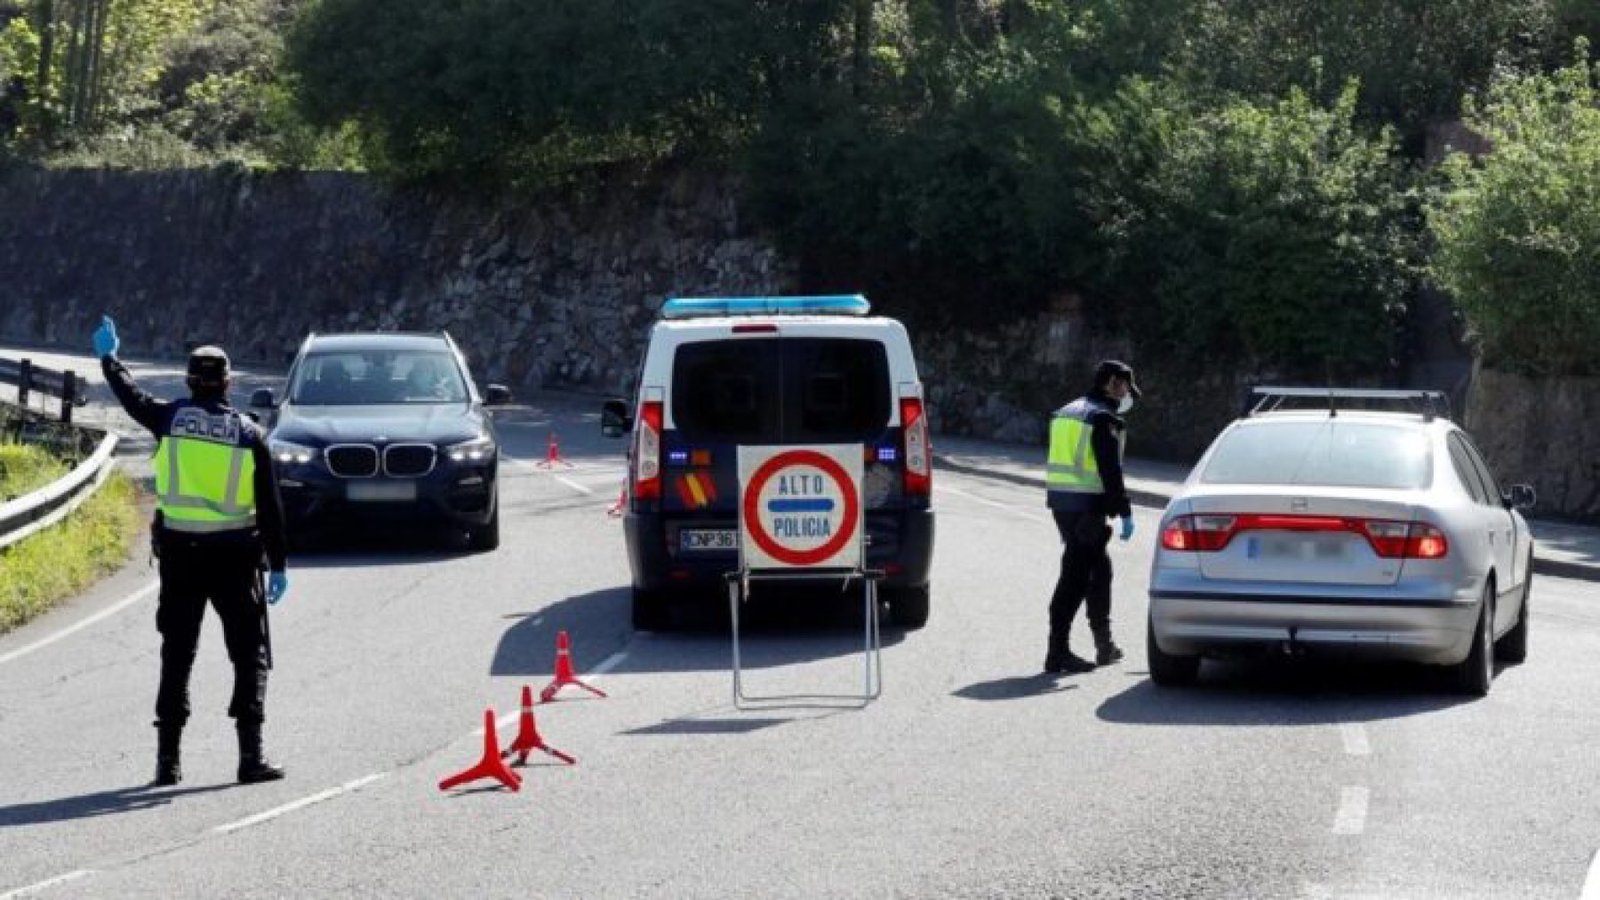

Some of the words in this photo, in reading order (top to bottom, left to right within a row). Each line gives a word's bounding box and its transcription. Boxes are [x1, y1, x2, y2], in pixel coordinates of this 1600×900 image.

[778, 475, 822, 495] ALTO
[774, 517, 831, 537] POLICIA
[689, 532, 738, 547] CNP36
